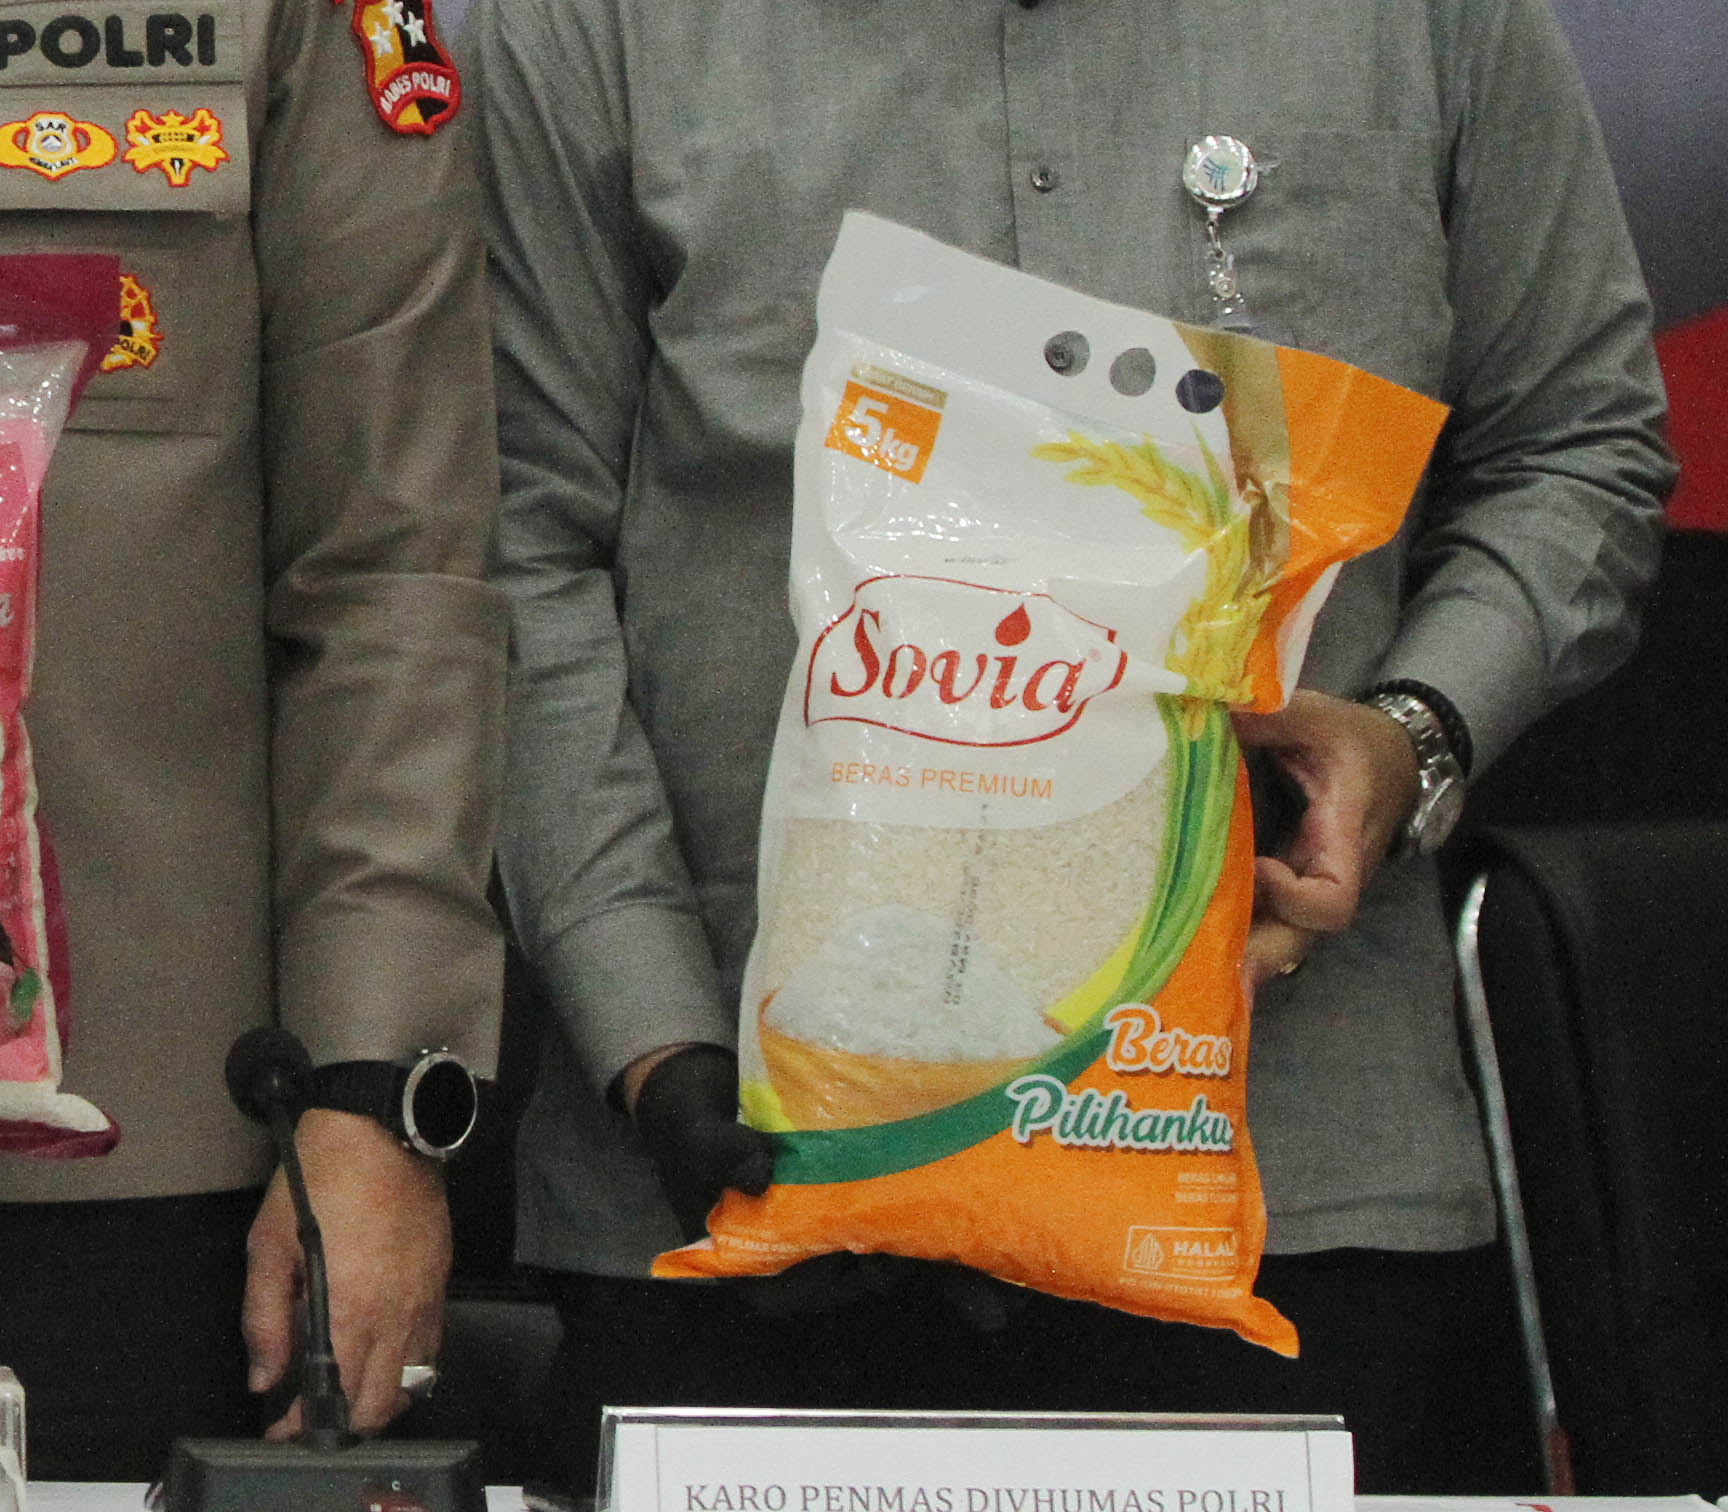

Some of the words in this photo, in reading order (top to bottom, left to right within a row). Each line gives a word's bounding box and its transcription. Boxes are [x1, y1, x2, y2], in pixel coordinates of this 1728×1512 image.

[411, 72, 451, 98] POLRI
[35, 120, 68, 134] SAR
[830, 601, 1087, 715] Sovia
[831, 761, 911, 788] BERAS
[921, 767, 1054, 799] PREMIUM
[1104, 1003, 1232, 1076] Beras
[1006, 1074, 1234, 1151] Pilihanku
[684, 1484, 787, 1512] KARO
[800, 1485, 955, 1512] PENMAS
[965, 1487, 1165, 1512] DIVHUMAS
[1177, 1489, 1287, 1512] POLRI
